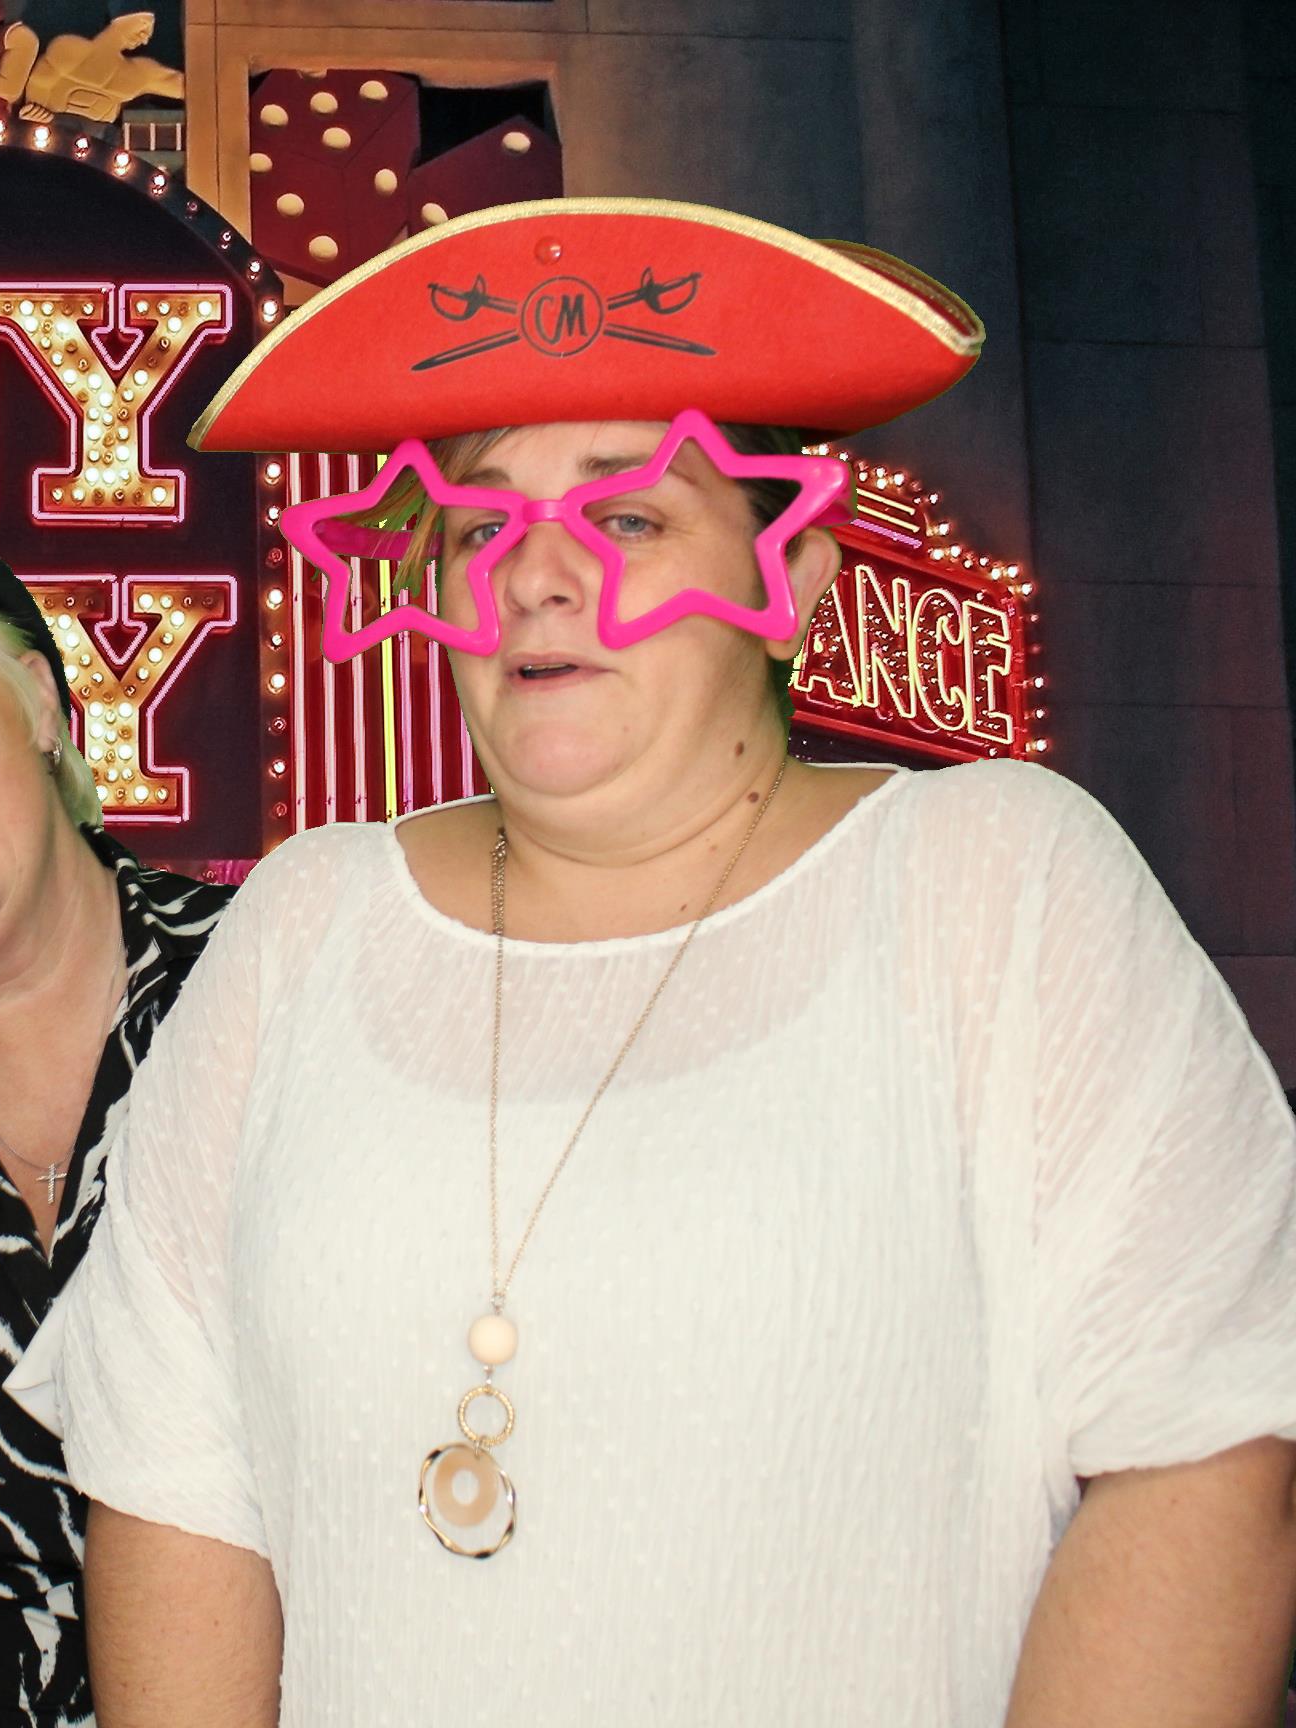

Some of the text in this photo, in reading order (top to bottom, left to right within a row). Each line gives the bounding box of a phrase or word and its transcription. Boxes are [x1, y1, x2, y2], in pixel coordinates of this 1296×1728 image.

[535, 293, 588, 345] CM
[13, 575, 238, 823] Y
[789, 564, 1014, 744] ANCE
